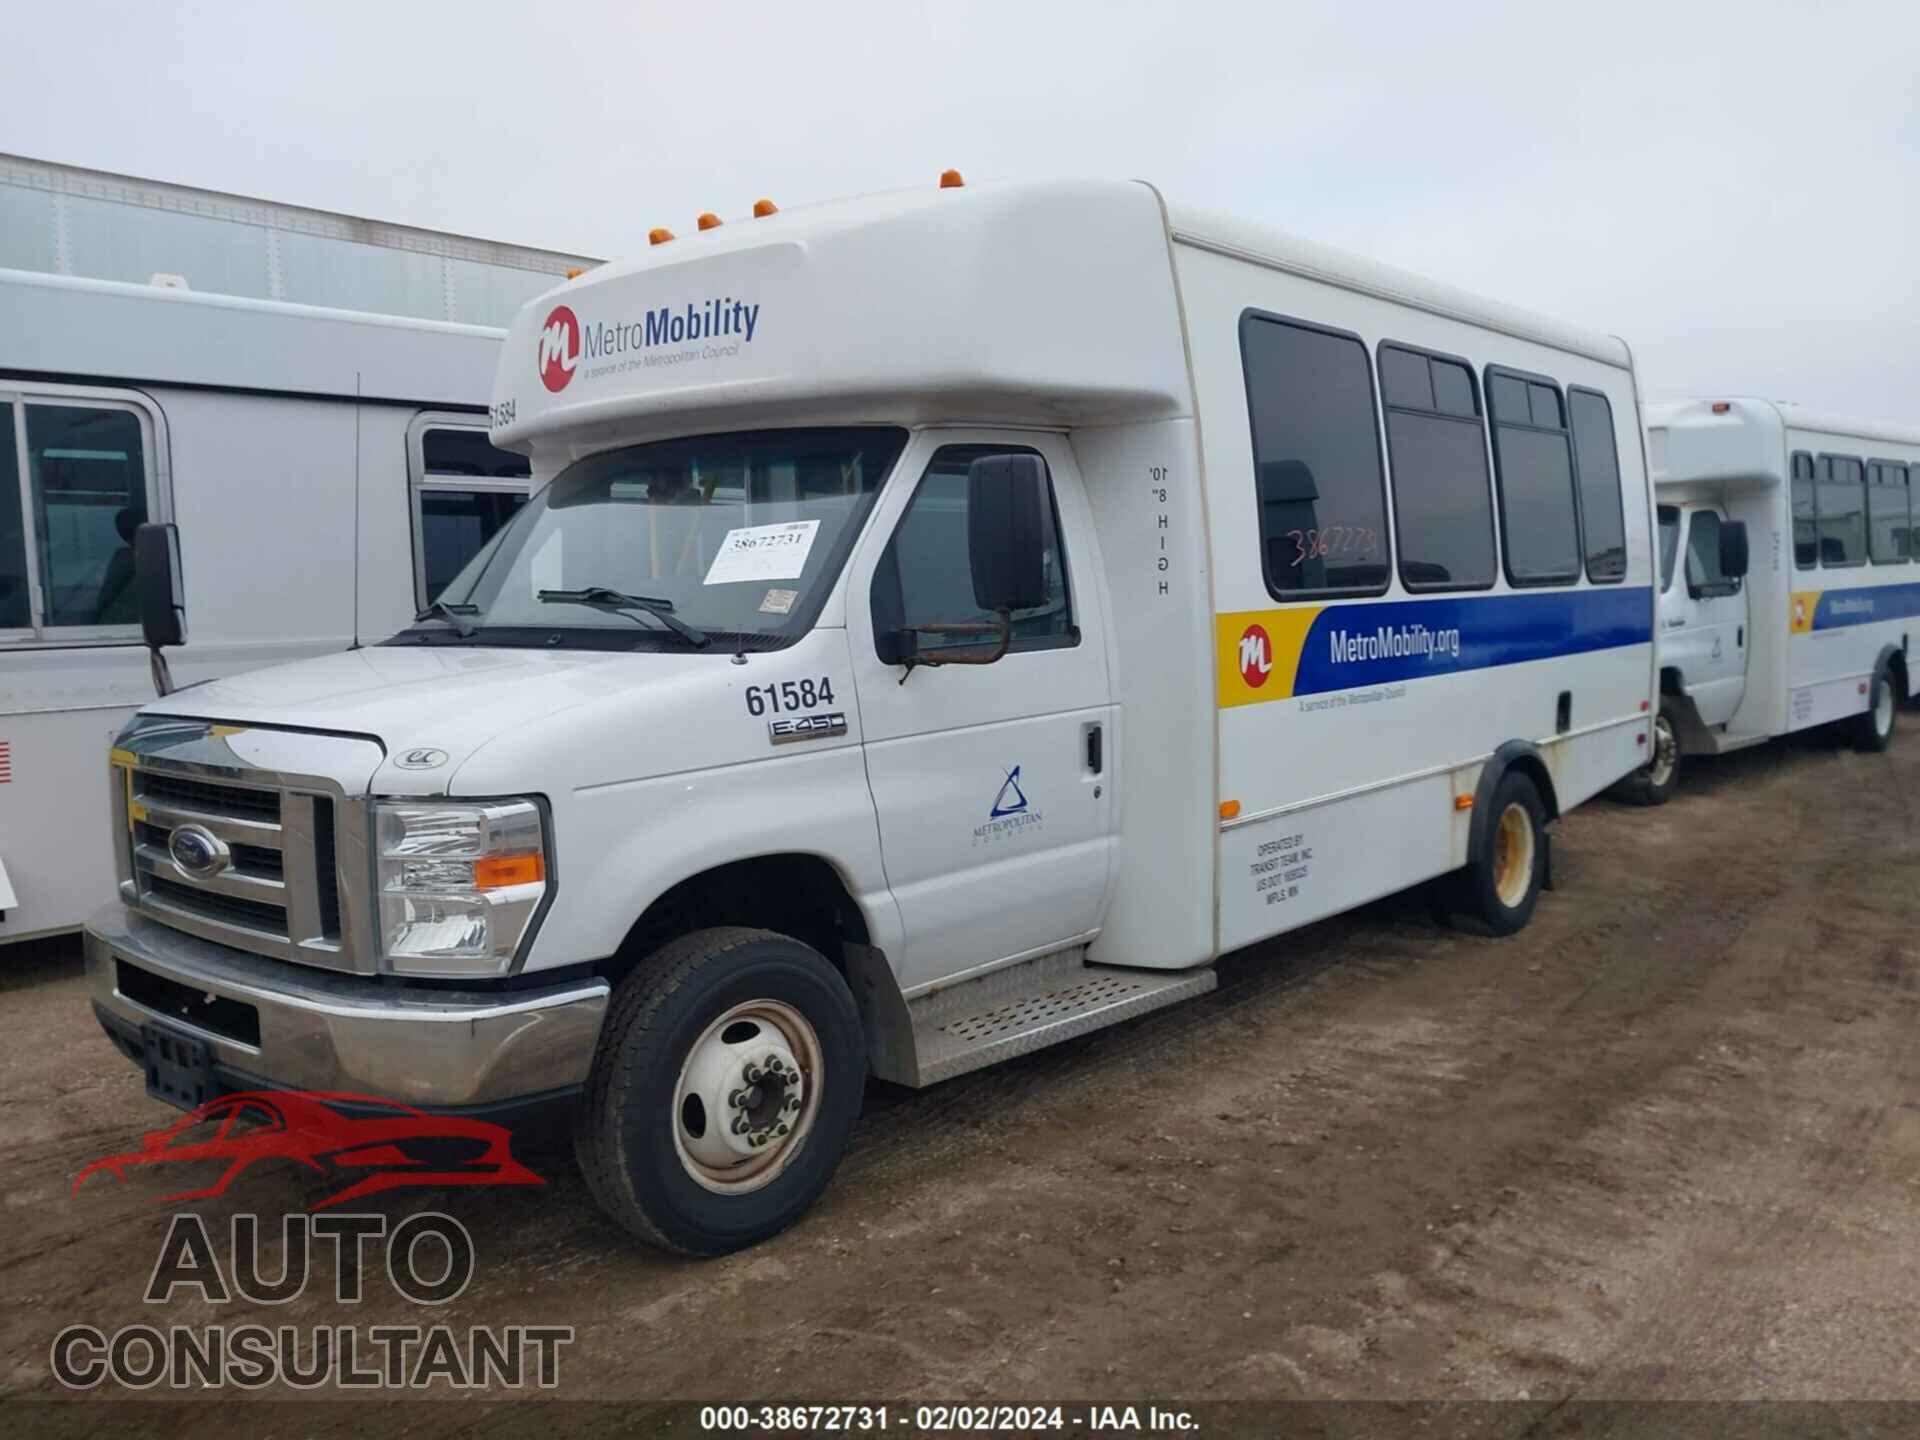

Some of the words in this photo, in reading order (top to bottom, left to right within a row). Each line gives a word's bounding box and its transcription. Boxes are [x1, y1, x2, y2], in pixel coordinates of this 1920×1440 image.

[584, 297, 760, 360] MetroMobility
[628, 358, 642, 371] the
[643, 348, 700, 369] Metropolitan
[702, 341, 740, 360] Council
[1330, 624, 1460, 664] MetroMobility.org
[745, 677, 834, 716] 61584
[973, 812, 1043, 837] METROPOLITAN
